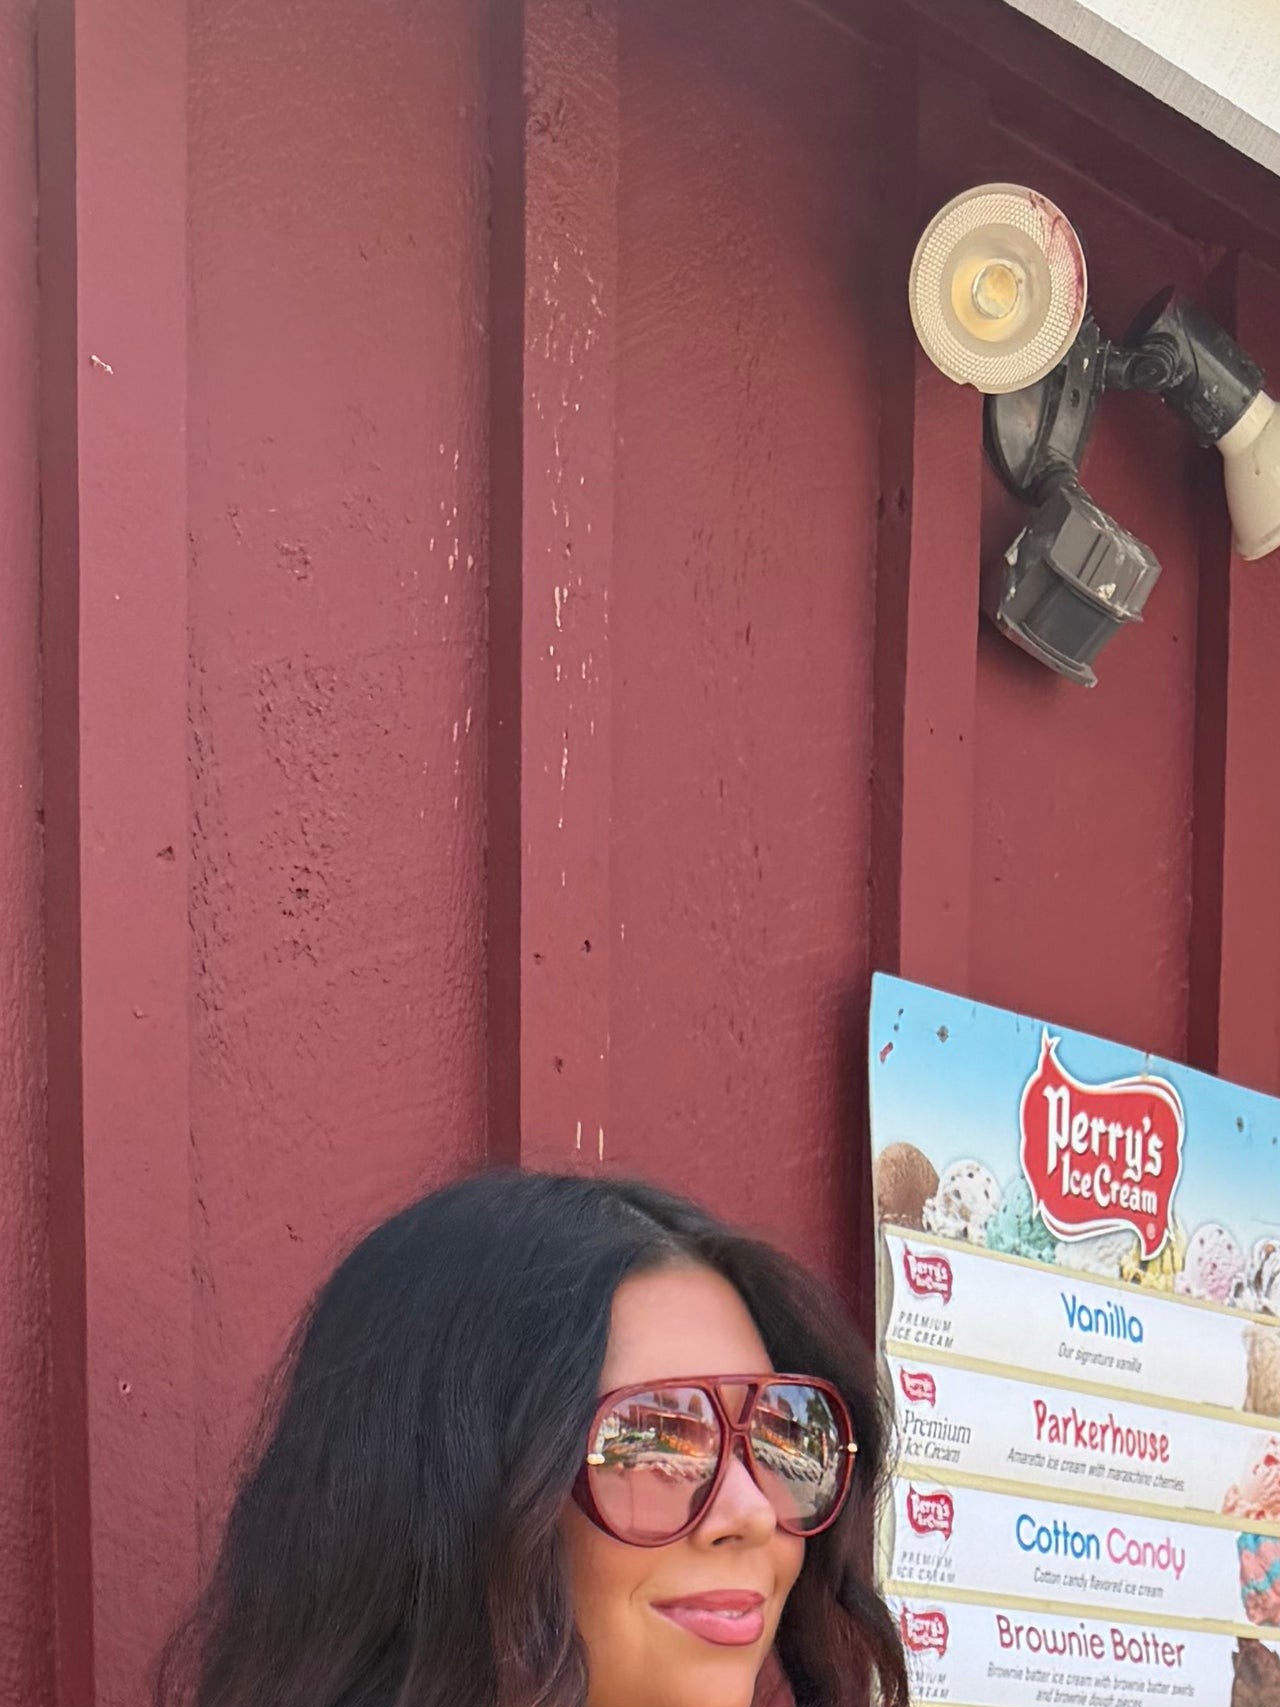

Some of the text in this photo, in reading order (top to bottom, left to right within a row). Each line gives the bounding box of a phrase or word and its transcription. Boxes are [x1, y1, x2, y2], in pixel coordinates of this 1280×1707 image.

[1044, 1085, 1164, 1182] Perry's
[899, 1311, 951, 1332] PREMIUM
[1061, 1292, 1144, 1343] Vanilla
[893, 1327, 954, 1348] ICE CREAM
[1058, 1342, 1142, 1373] Our signature vanilla
[903, 1409, 971, 1444] Premium
[1033, 1399, 1170, 1463] Parkerhouse
[904, 1437, 960, 1463] Ice Cream
[1047, 1456, 1060, 1470] ice
[1062, 1460, 1086, 1474] cream
[1087, 1462, 1105, 1478] with
[1016, 1514, 1186, 1580] Cotton Candy
[1034, 1567, 1164, 1598] Cotton candy flavored ice cream
[996, 1614, 1185, 1668] Brownie Batter
[1066, 1673, 1092, 1687] cream
